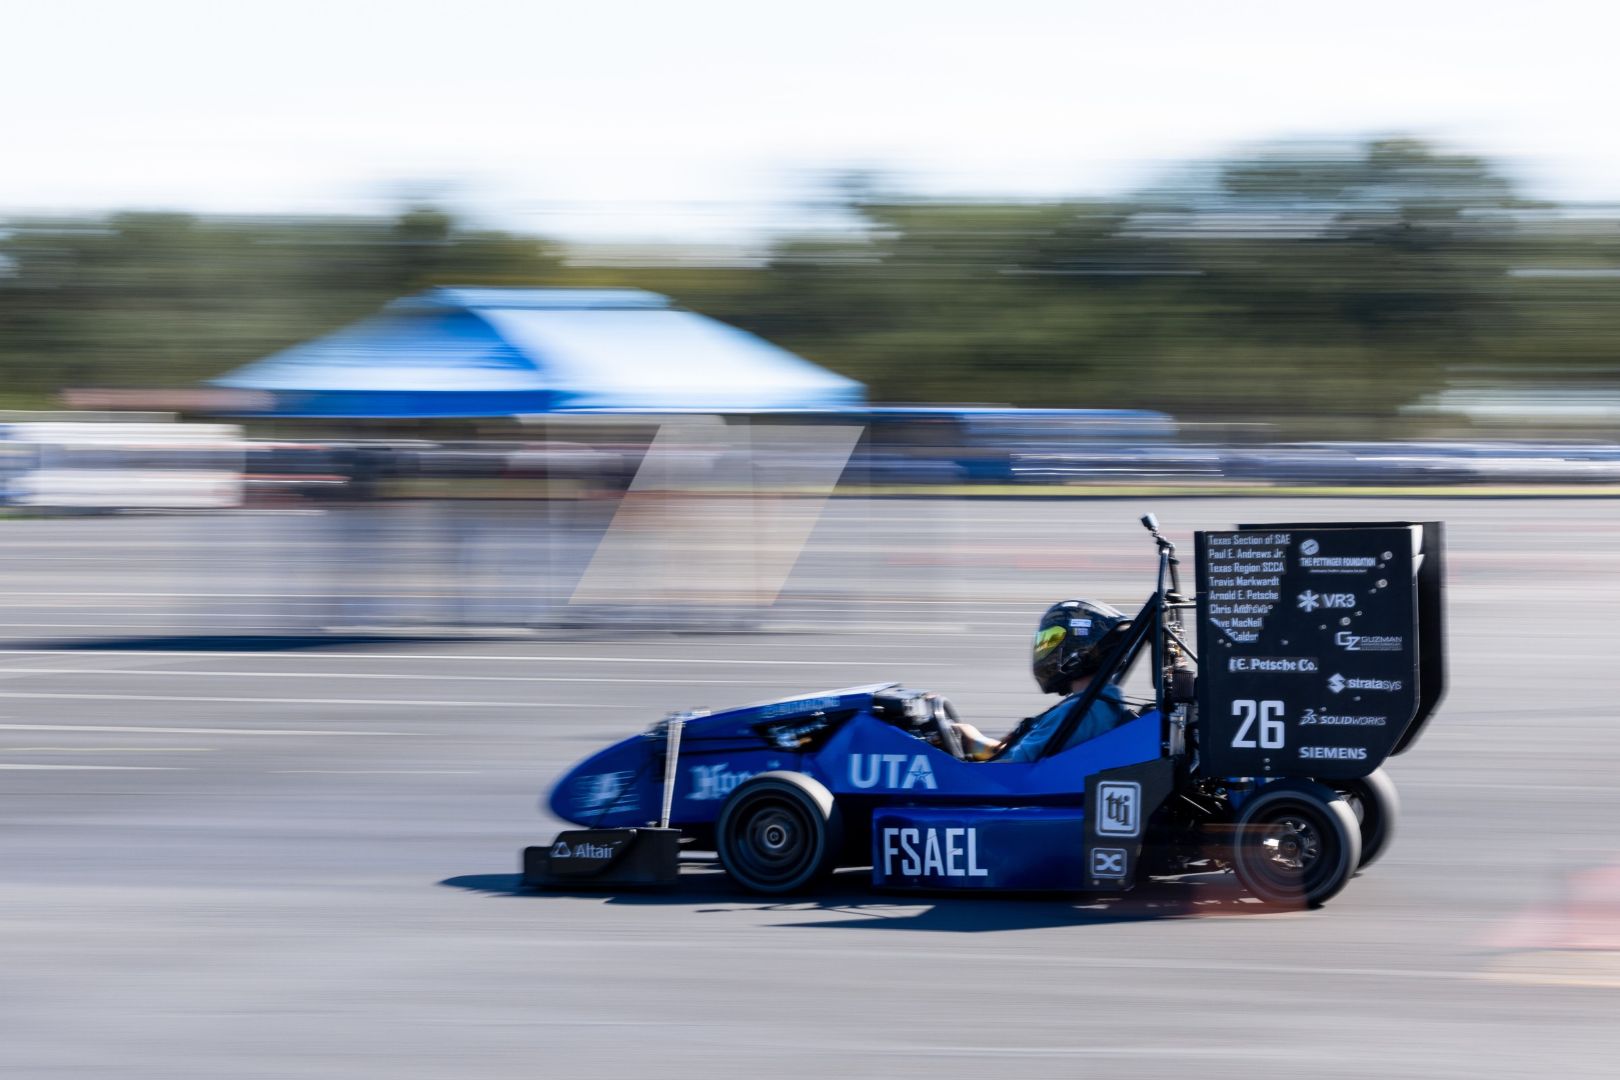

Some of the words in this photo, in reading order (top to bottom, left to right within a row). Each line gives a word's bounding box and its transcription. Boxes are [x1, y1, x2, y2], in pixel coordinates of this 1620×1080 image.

[1208, 535, 1231, 545] Texas
[1233, 535, 1263, 545] Section
[1265, 534, 1273, 544] of
[1275, 534, 1291, 544] SAE
[1208, 549, 1226, 559] Paul
[1228, 549, 1235, 558] E.
[1237, 549, 1271, 558] Andrews
[1274, 548, 1285, 558] Jr.
[1208, 563, 1232, 572] Texas
[1234, 562, 1260, 574] Region
[1263, 562, 1284, 572] SCCA
[1301, 557, 1313, 567] THE
[1209, 577, 1234, 586] Travis
[1236, 576, 1279, 586] Markwardt
[1210, 590, 1236, 600] Arnold
[1247, 590, 1279, 600] Petsche
[1322, 593, 1356, 608] VR3
[1210, 604, 1232, 613] Chris
[1231, 617, 1263, 628] MacNeil
[1250, 658, 1296, 671] Petsche
[1298, 659, 1318, 671] Co.
[1346, 678, 1402, 692] stratasys
[1231, 699, 1285, 749] 26
[1319, 715, 1387, 726] SOLIDWORKS
[1299, 746, 1367, 760] SIEMENS
[848, 753, 938, 789] UTA
[574, 843, 614, 859] Altair
[883, 827, 988, 876] FSAEL
